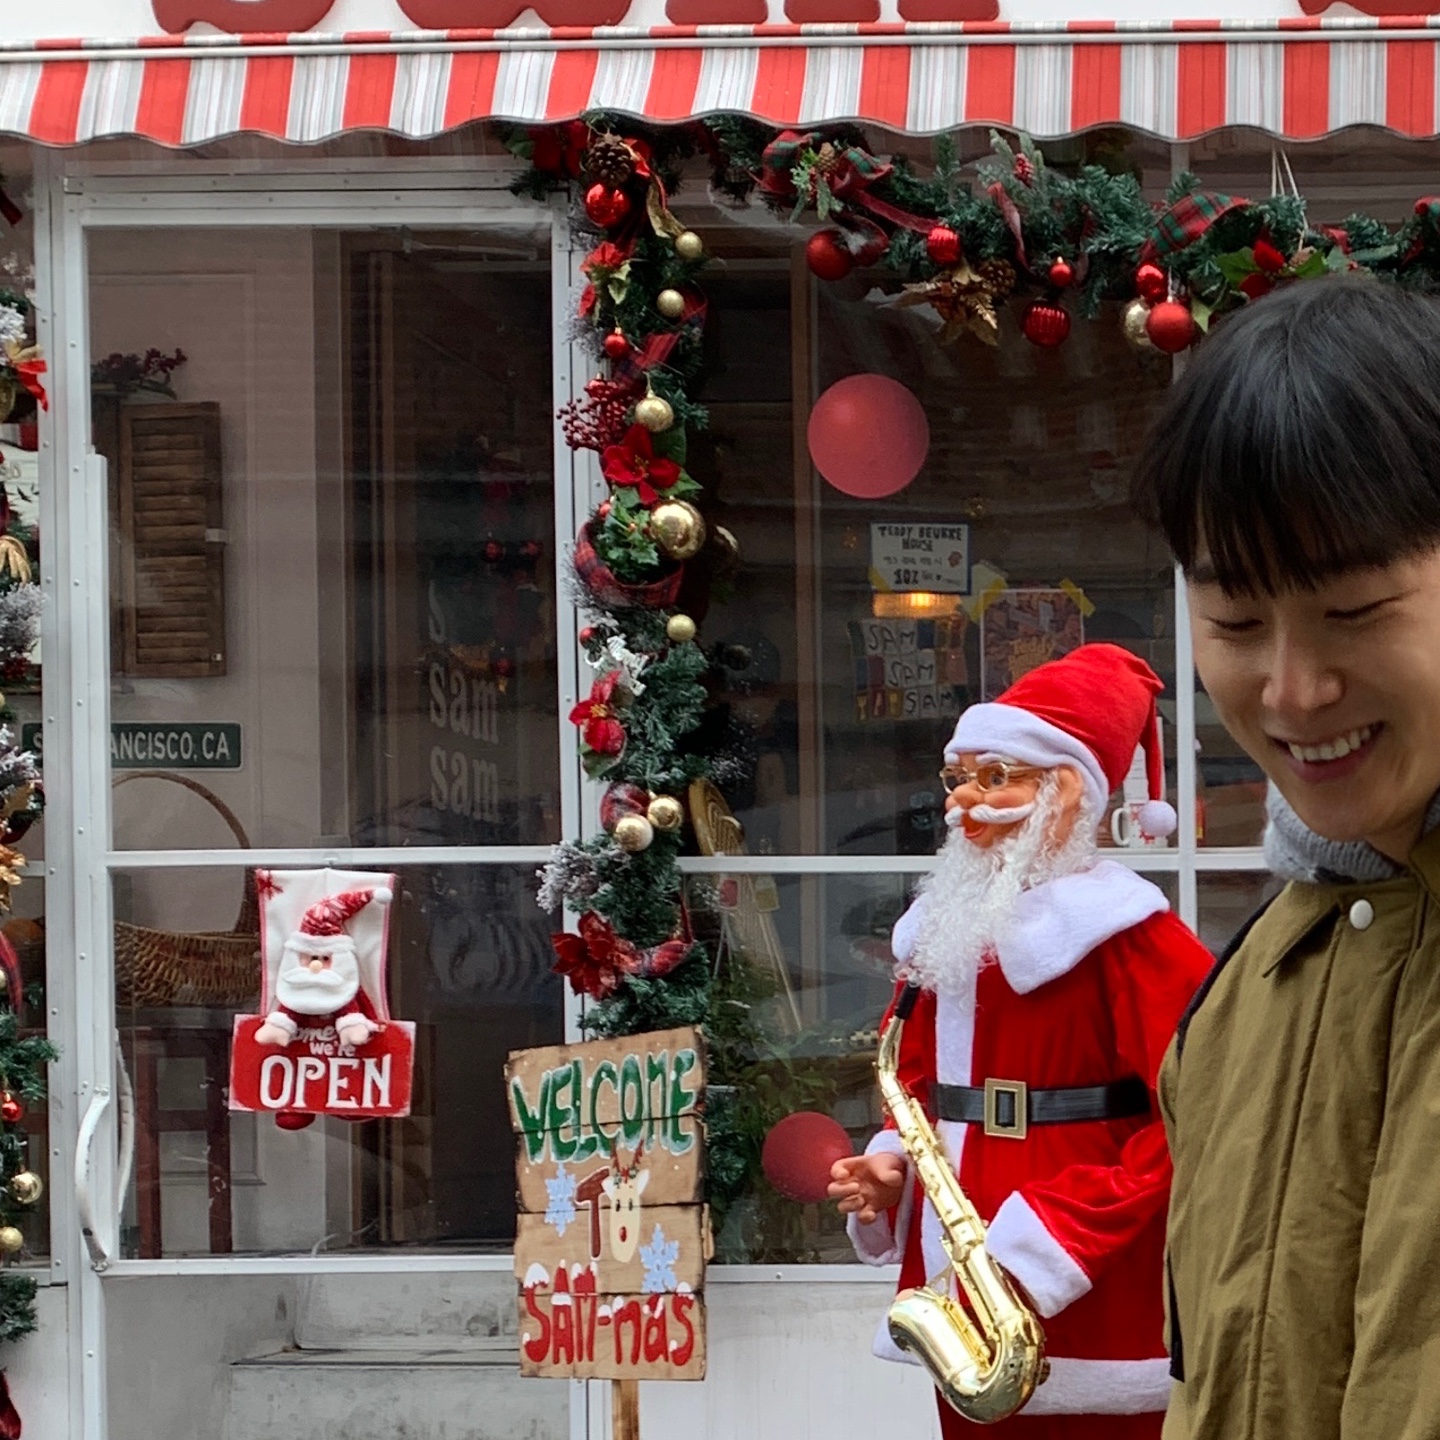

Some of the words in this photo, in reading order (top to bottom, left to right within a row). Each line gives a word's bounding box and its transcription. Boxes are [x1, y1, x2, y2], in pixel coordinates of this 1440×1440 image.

[878, 525, 913, 540] TEDDY
[902, 539, 933, 551] HOUSE
[868, 624, 915, 650] SAM
[888, 661, 934, 687] SAM
[905, 692, 953, 714] SAM
[110, 731, 198, 761] ANCISCO,
[202, 731, 231, 760] CA
[290, 1026, 337, 1042] ome
[309, 1041, 356, 1057] we're
[259, 1053, 392, 1109] OPEN
[510, 1048, 698, 1165] WELCOME
